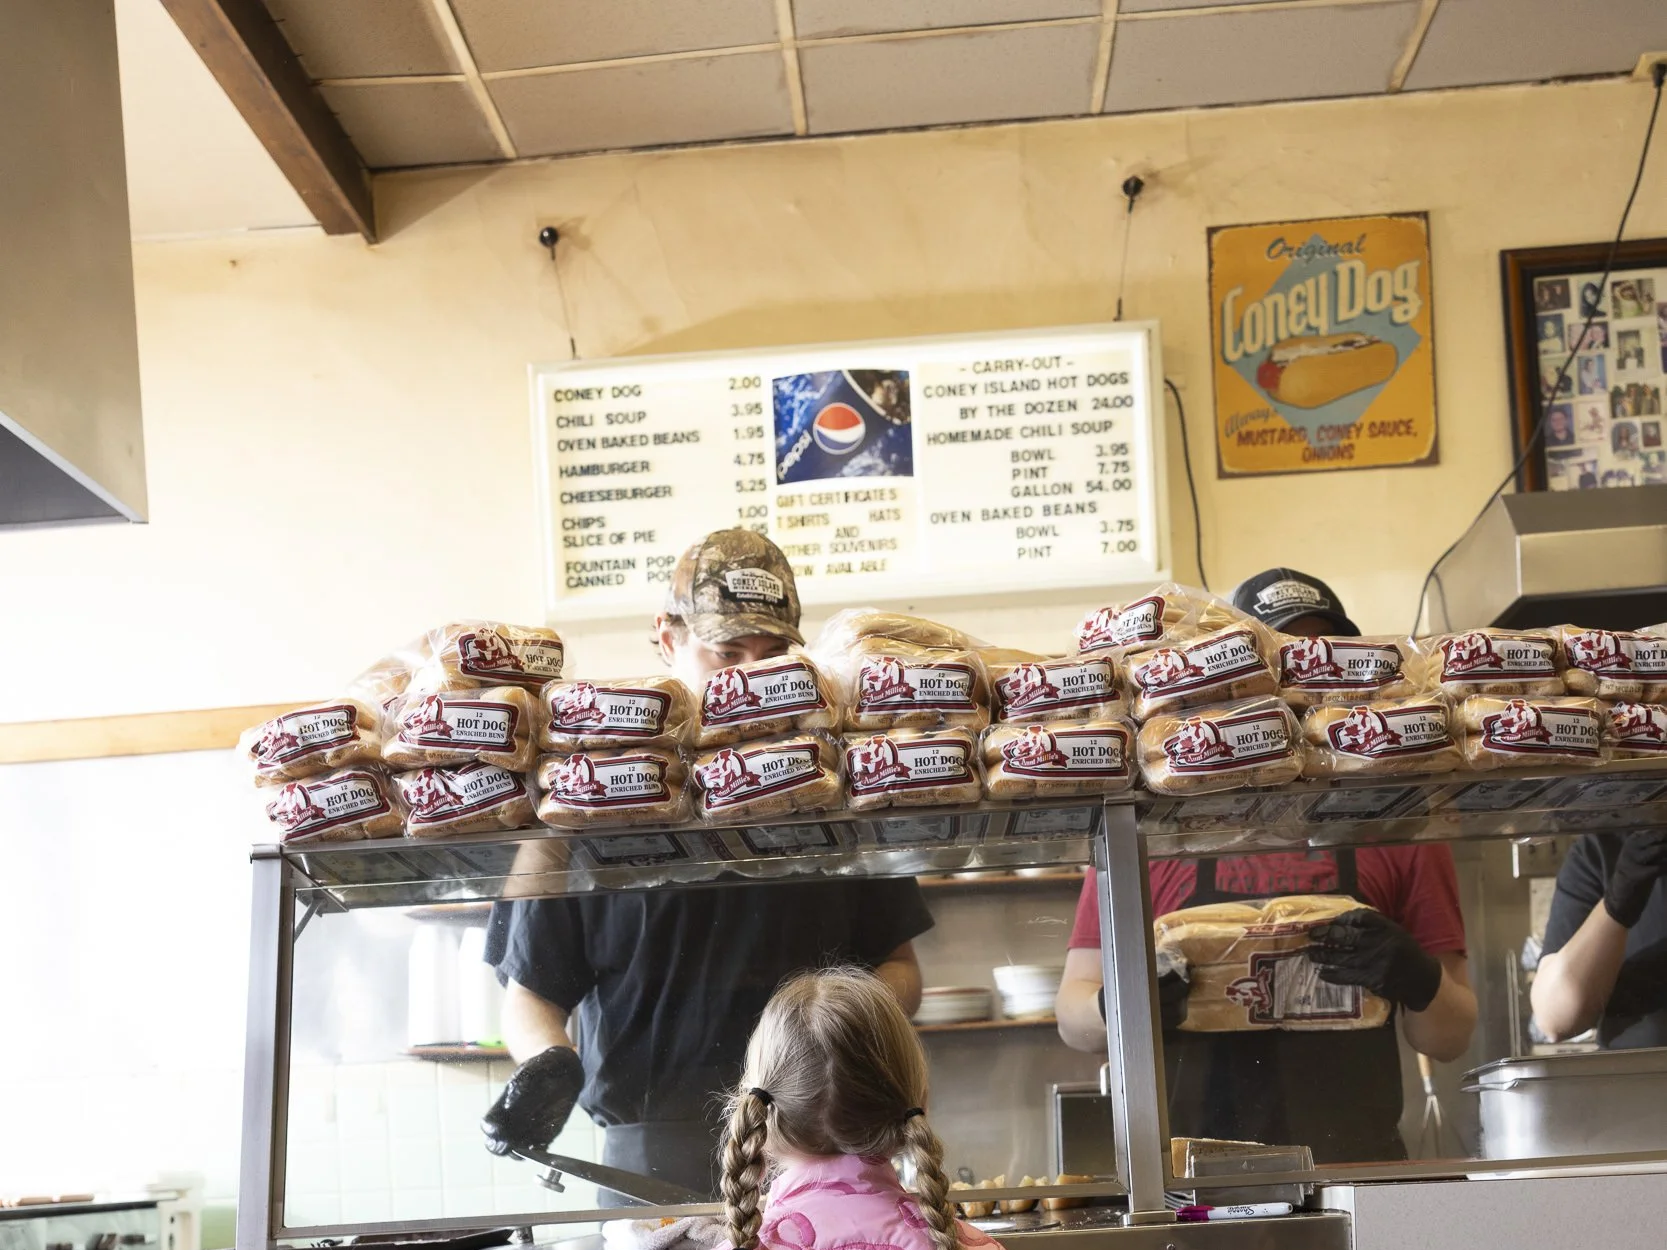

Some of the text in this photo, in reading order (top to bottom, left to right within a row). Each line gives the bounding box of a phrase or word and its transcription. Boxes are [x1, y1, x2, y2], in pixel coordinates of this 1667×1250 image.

[1265, 233, 1367, 266] Original
[1222, 259, 1423, 363] Coney Dog
[554, 376, 762, 402] CONEY DOG 2.00
[923, 372, 1129, 398] CONEY ISLAND HOT DOGS
[960, 395, 1134, 419] BY THE DOZEN 24.00
[556, 402, 763, 428] CHILI SOUP 3.95
[927, 420, 1113, 445] HOMEMADE CHILI SOUP
[1316, 422, 1363, 441] CONEY
[1368, 418, 1418, 438] SAUCE,
[557, 426, 764, 452] OVEN BAKED BEANS 1.95
[1011, 449, 1055, 463] BOWL
[1302, 443, 1355, 463] ONIONS
[559, 452, 765, 478] HAMBURGER 4.75
[1012, 461, 1130, 480] PINT 7.75
[560, 479, 767, 504] CHEESEBURGER 5.25
[1011, 478, 1132, 498] GALLON 54.00
[562, 505, 768, 531] CHIPS 1.00
[787, 513, 829, 528] SHIRTS
[869, 508, 901, 522] HATS
[930, 501, 1098, 524] OVEN BAKED BEANS
[835, 525, 860, 539] AND
[1016, 519, 1135, 539] BOWL 3.75
[563, 530, 656, 548] SLICE OF PIE
[829, 538, 897, 554] SOUVENIRS
[1017, 540, 1137, 559] PINT 7.00
[565, 555, 676, 574] FOUNTAIN POP
[566, 574, 625, 588] CANNED
[732, 577, 756, 586] CONEY
[1205, 650, 1230, 665] HOT
[1508, 650, 1530, 659] HOT
[1635, 650, 1658, 659] HOT
[1208, 659, 1238, 671] ENRICHED
[1348, 659, 1396, 670] HOT DOG
[765, 680, 813, 695] HOT DOG
[920, 679, 943, 688] HOT
[1063, 675, 1085, 687] HOT
[885, 686, 906, 696] Millie's
[1029, 687, 1049, 700] Millie's
[1063, 686, 1094, 694] ENRICHED
[716, 695, 751, 714] Aunt Millie's
[765, 693, 796, 703] ENRICHED
[610, 705, 658, 718] HOT DOG
[300, 722, 319, 734] HOT
[457, 718, 506, 731] HOT DOG
[1404, 723, 1425, 734] HOT
[1556, 724, 1578, 735] HOT
[1236, 729, 1284, 745] HOT DOG
[1371, 734, 1392, 745] Millie's
[1072, 747, 1119, 757] HOT DOG
[1203, 745, 1224, 757] Millie's
[1238, 742, 1269, 753] ENRICHED
[915, 756, 964, 767] HOT DOG
[1036, 753, 1058, 762] Millie's
[762, 759, 784, 773] HOT
[880, 766, 900, 778] Millie's
[915, 767, 946, 775] ENRICHED
[611, 774, 633, 785] HOT
[765, 767, 794, 780] ENRICHED
[464, 772, 509, 793] HOT DOG
[496, 782, 511, 791] BUNS
[610, 785, 642, 793] ENRICHED
[731, 776, 750, 789] Millie's
[326, 788, 374, 807] HOT DOG
[328, 802, 358, 814] ENRICHED
